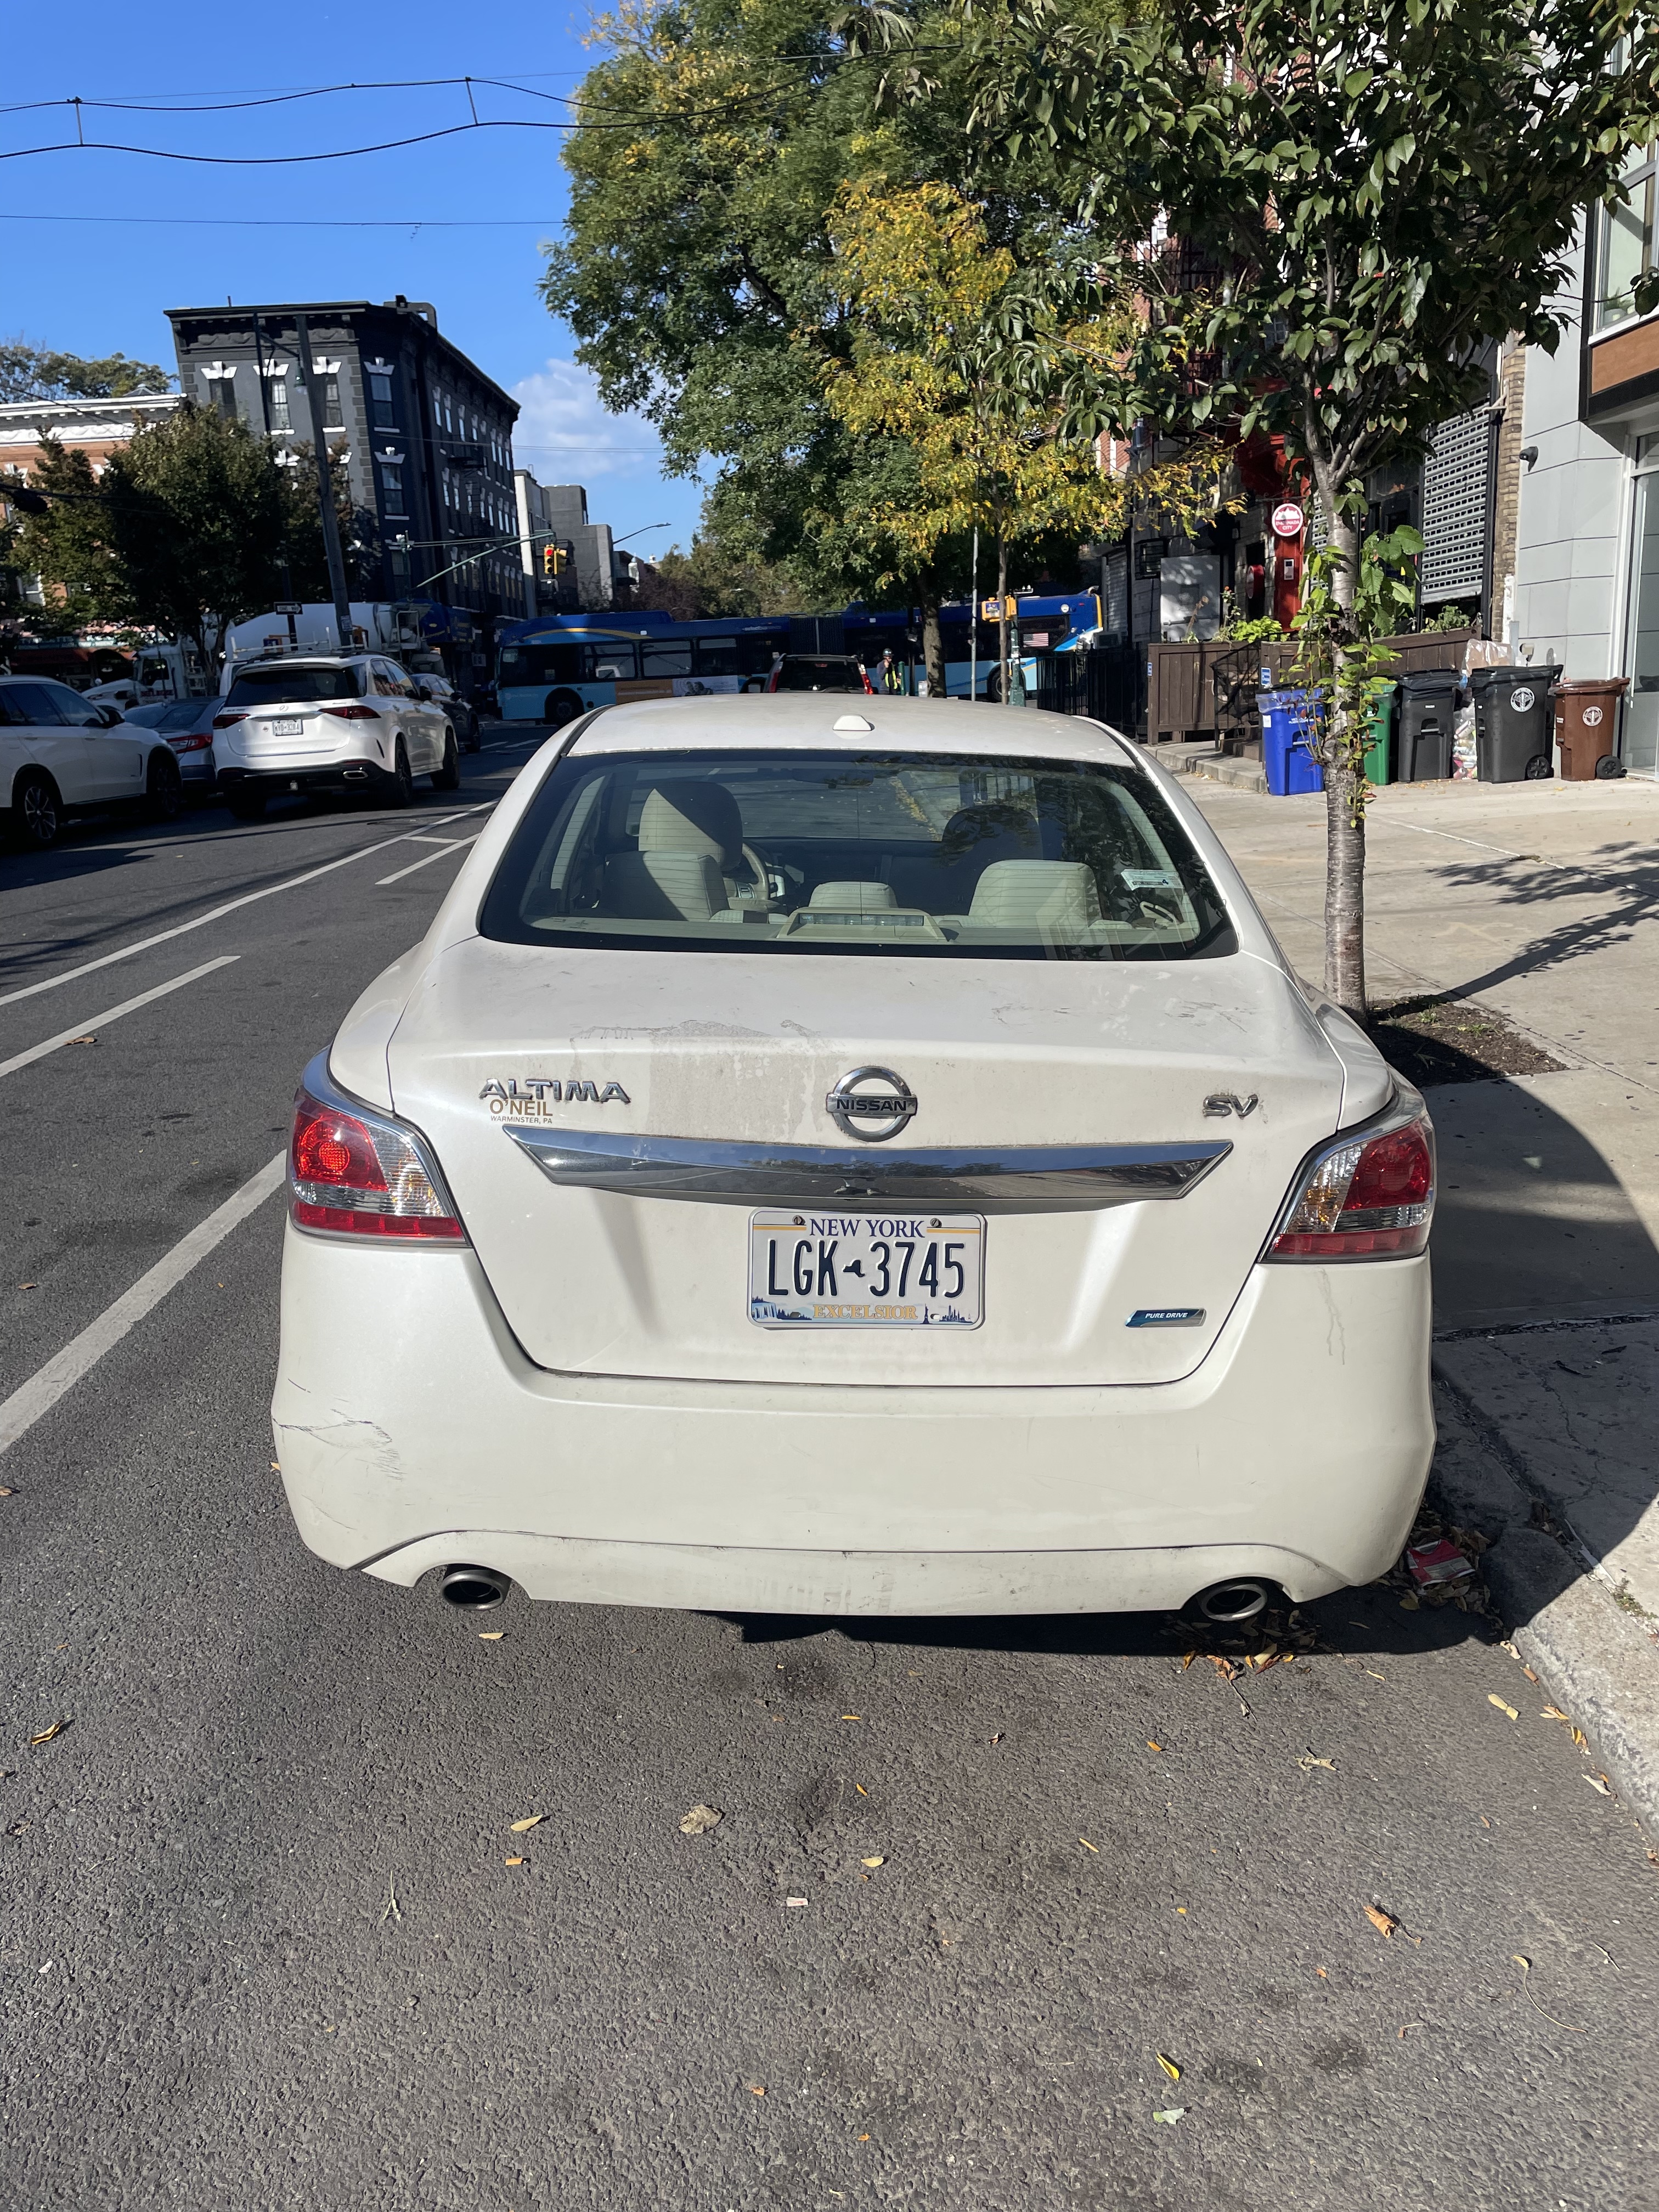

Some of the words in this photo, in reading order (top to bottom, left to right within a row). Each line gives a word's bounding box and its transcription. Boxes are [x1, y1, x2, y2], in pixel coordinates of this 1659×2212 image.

[478, 1078, 631, 1104] ALTIMA
[490, 1099, 553, 1116] O'NEIL
[837, 1099, 907, 1111] NISSAN
[1203, 1094, 1259, 1117] SV
[490, 1116, 541, 1124] WARMINSTER,
[810, 1218, 861, 1237] NEW
[865, 1219, 925, 1238] YORK
[768, 1239, 839, 1296] LGK
[870, 1241, 964, 1298] 3745
[812, 1304, 918, 1320] EXCELSIOR
